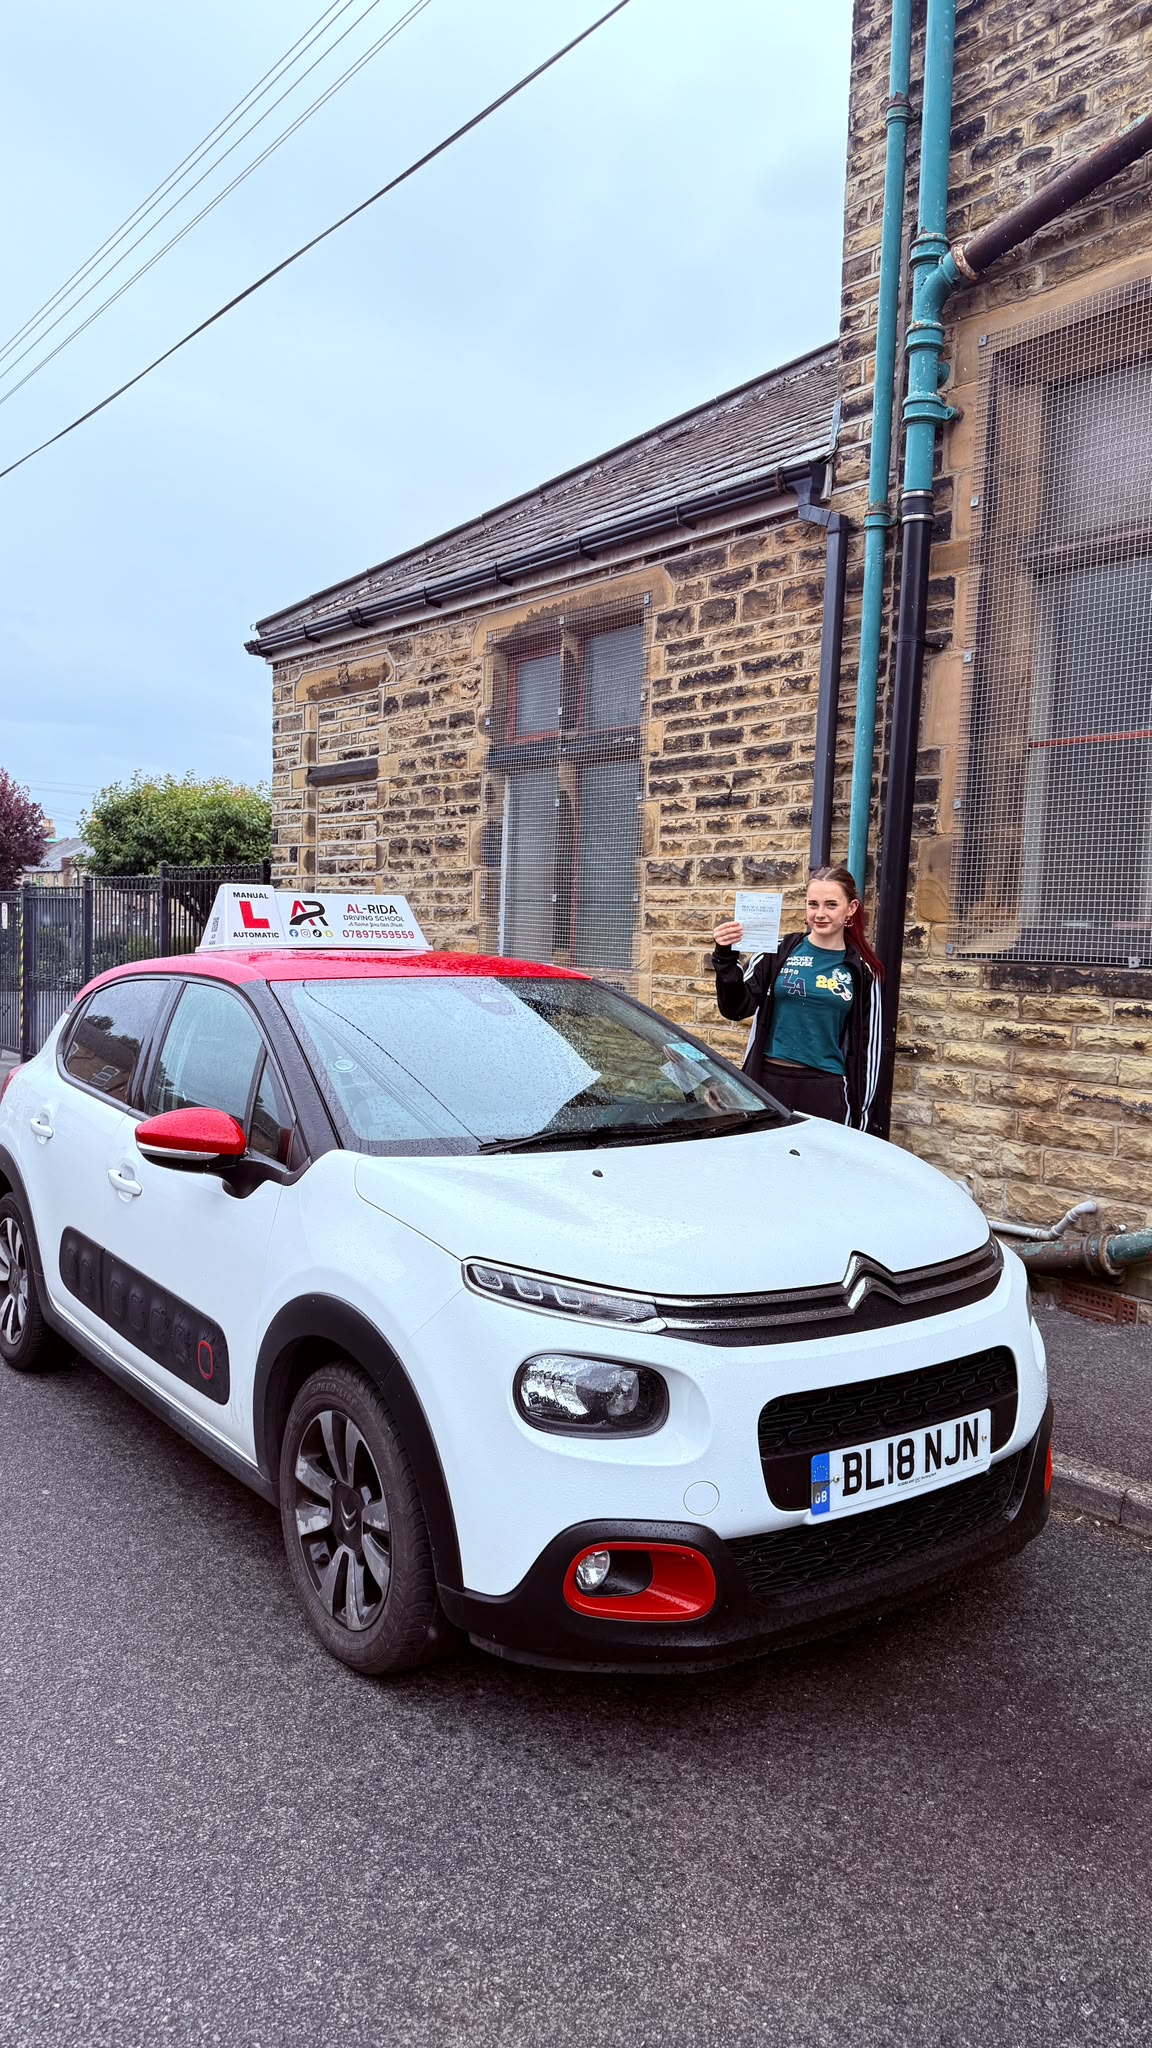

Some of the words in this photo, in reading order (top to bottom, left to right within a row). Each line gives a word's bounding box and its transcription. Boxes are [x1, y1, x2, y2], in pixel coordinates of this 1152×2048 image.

[239, 901, 270, 928] L
[347, 903, 398, 914] AL-RIDA
[343, 930, 415, 939] 07897559559
[842, 1437, 915, 1497] BL18
[925, 1418, 979, 1474] NJN
[815, 1490, 827, 1504] GB
